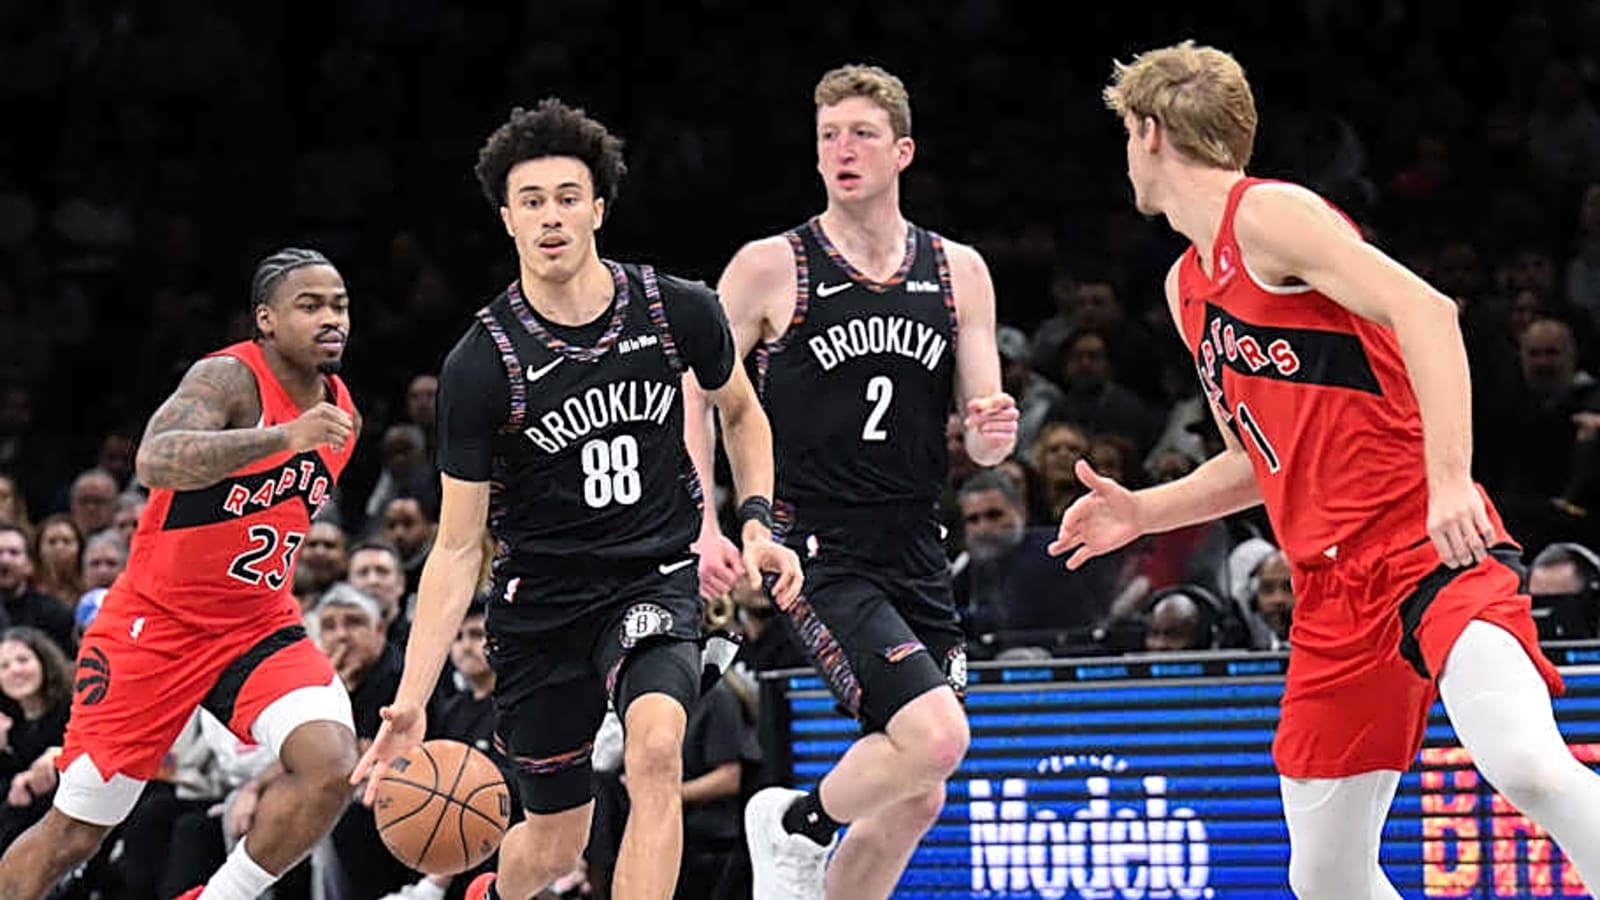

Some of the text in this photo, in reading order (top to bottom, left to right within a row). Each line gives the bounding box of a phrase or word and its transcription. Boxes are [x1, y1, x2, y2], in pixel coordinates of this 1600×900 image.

[808, 316, 948, 372] BROOKLYN
[524, 381, 677, 455] BROOKLYN
[862, 375, 894, 441] 2
[1237, 401, 1280, 474] 1
[580, 434, 643, 510] 88
[227, 524, 305, 590] 23
[969, 776, 1209, 899] Modelo
